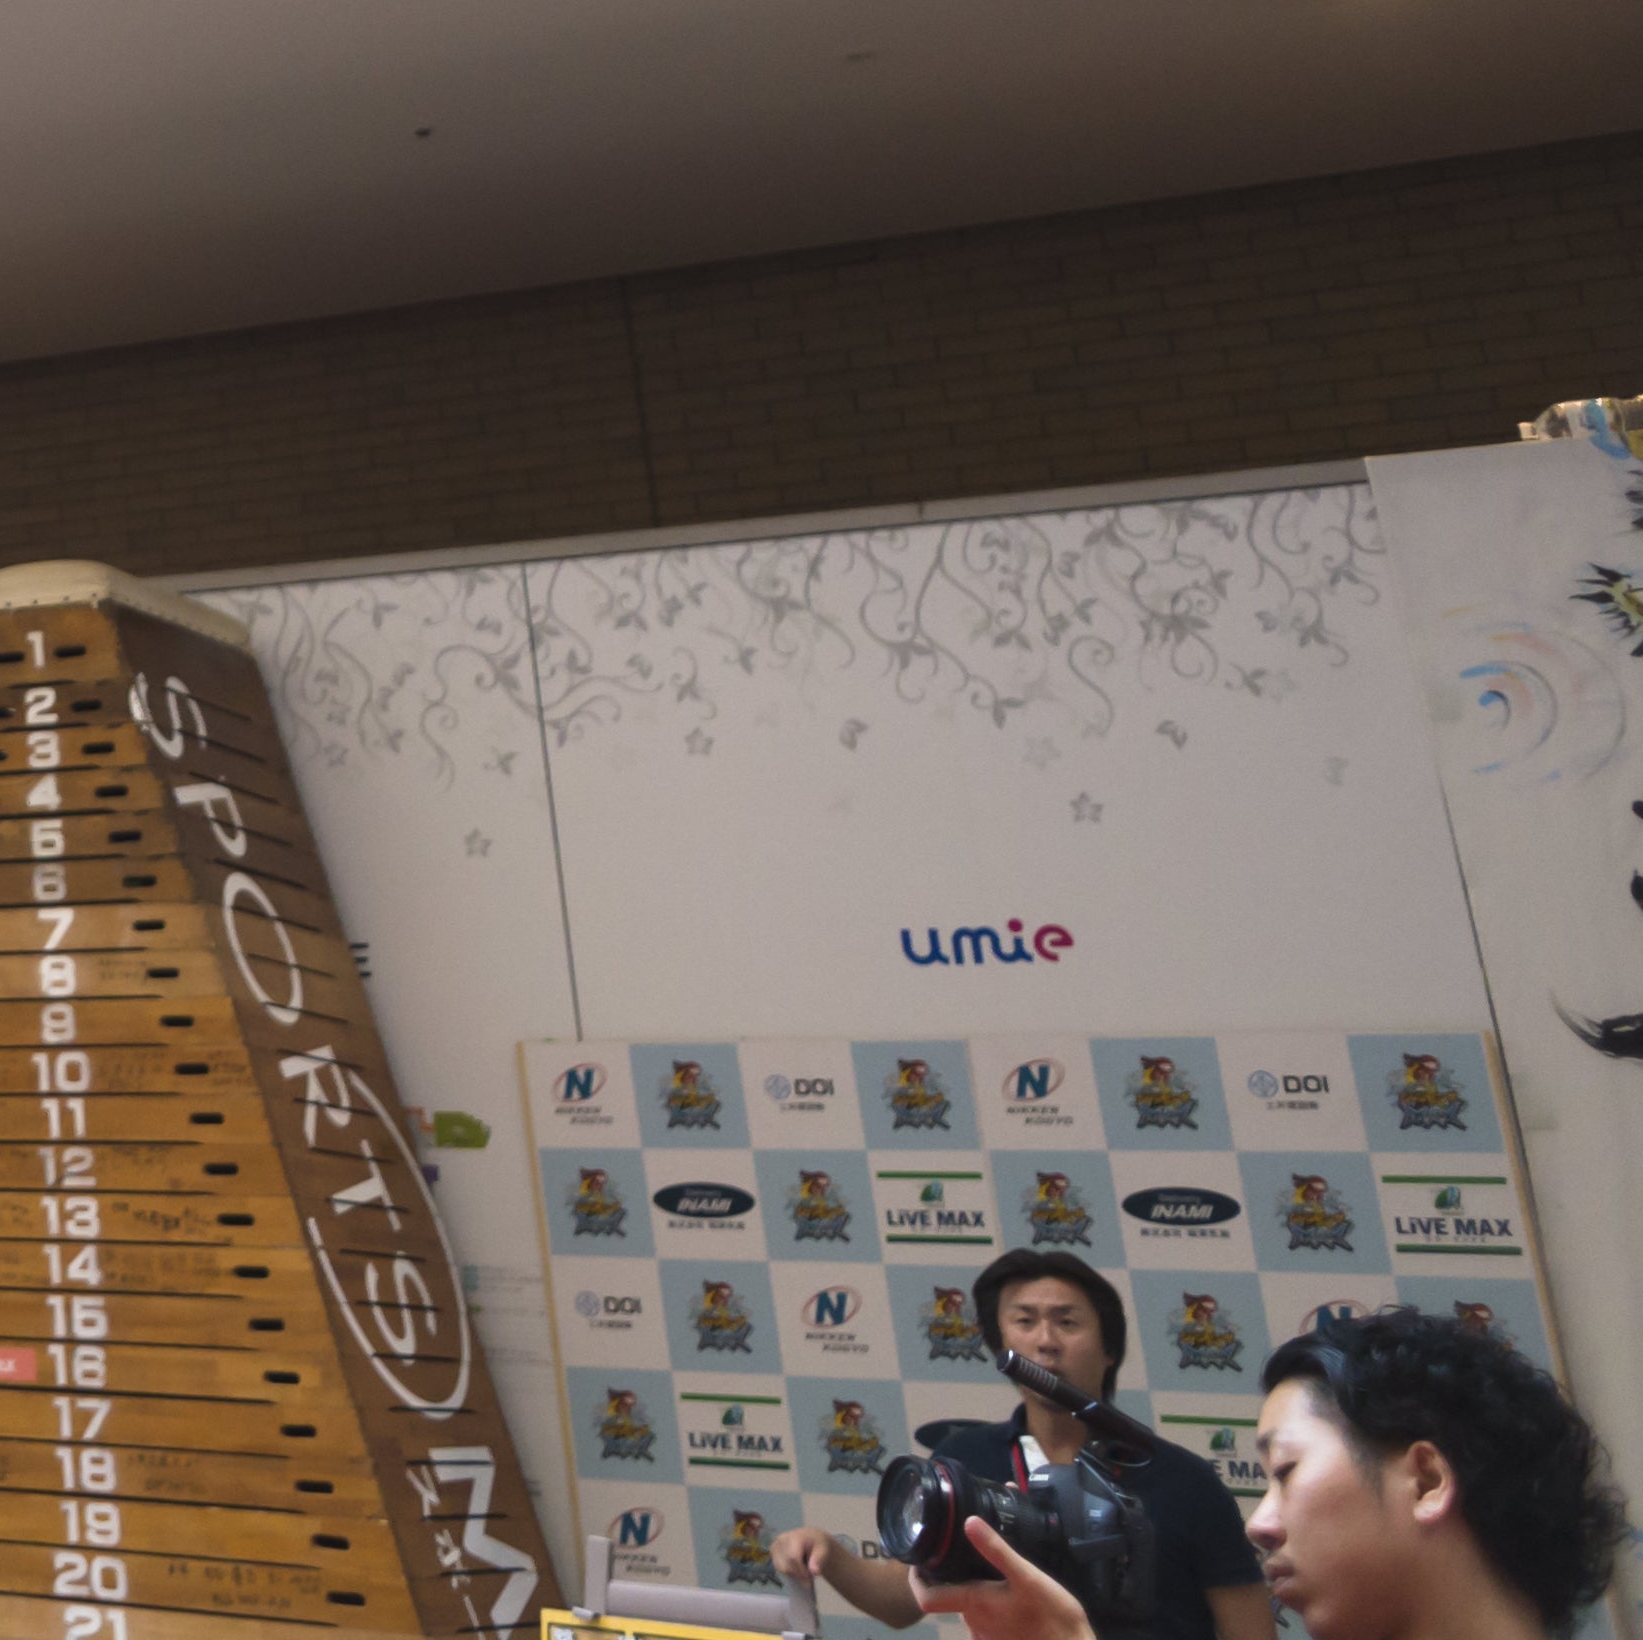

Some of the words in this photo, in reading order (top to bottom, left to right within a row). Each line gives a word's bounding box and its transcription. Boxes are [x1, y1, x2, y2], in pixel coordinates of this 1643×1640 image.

[26, 630, 46, 668] 1
[23, 686, 59, 725] 2
[26, 730, 60, 769] 3
[26, 773, 61, 811] 4
[31, 819, 65, 858] 5
[33, 862, 67, 902] 6
[37, 907, 75, 950] 7
[900, 917, 1075, 966] umie
[39, 954, 77, 997] 8
[40, 1002, 77, 1045] 9
[31, 1050, 91, 1093] 10
[1282, 1075, 1330, 1094] DOI
[41, 1097, 87, 1140] 11
[37, 1146, 98, 1188] 12
[40, 1195, 102, 1239] 13
[936, 1210, 986, 1229] MAX
[1149, 1203, 1215, 1220] INAMI
[1453, 1217, 1514, 1238] MAX
[43, 1244, 102, 1286] 14
[46, 1295, 109, 1341] 15
[47, 1343, 108, 1389] 16
[52, 1396, 112, 1441] 17
[736, 1433, 785, 1453] MAX
[55, 1446, 117, 1493] 18
[1228, 1460, 1269, 1481] MA
[60, 1500, 122, 1548] 19
[52, 1552, 128, 1601] 20
[65, 1605, 127, 1640] 21
